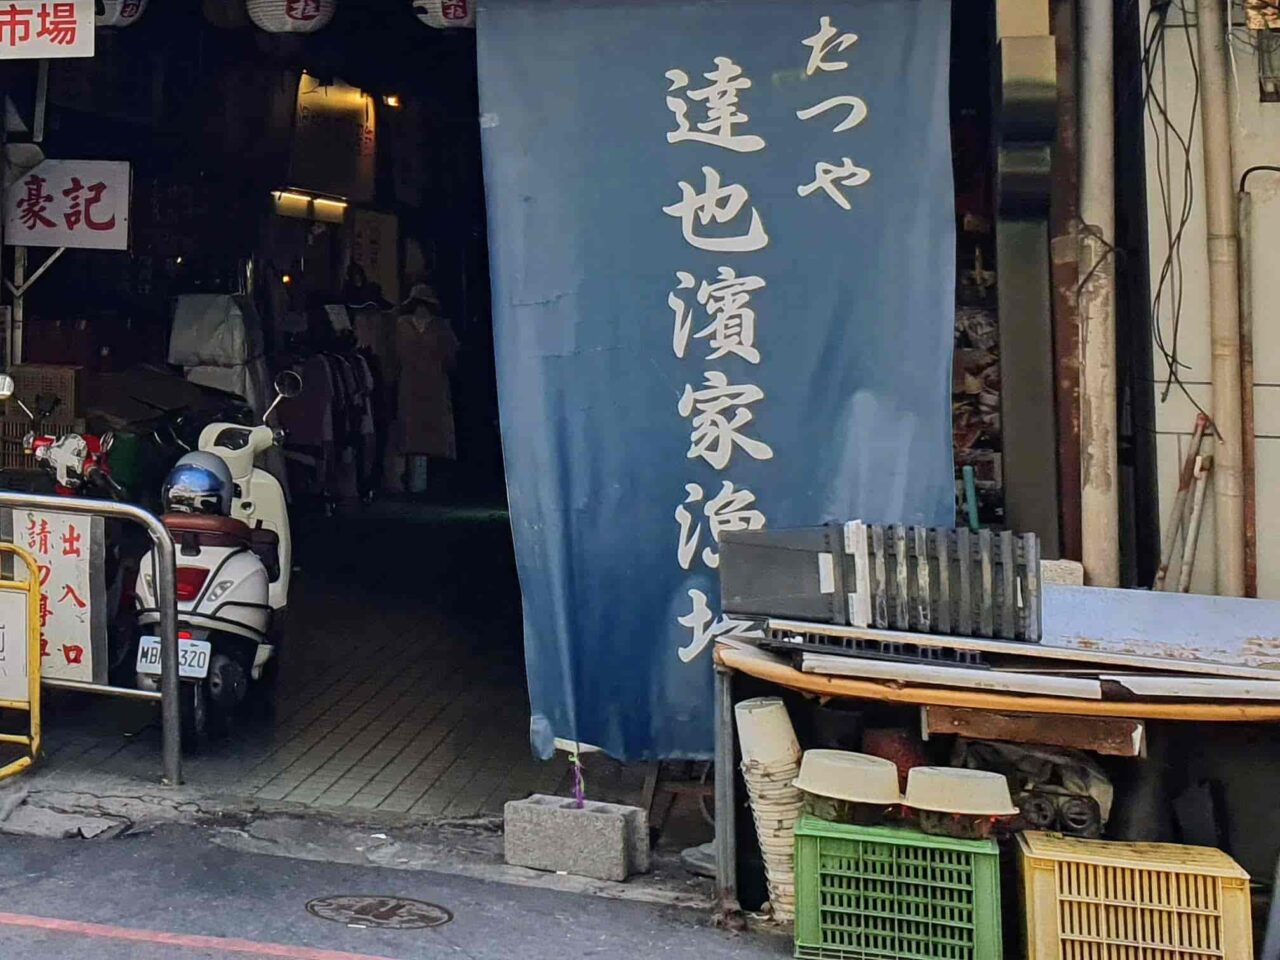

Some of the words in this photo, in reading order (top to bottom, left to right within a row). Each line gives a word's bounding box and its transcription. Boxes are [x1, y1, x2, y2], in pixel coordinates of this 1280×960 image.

[795, 15, 871, 210] たつや
[16, 174, 116, 232] 豪記
[57, 523, 86, 665] 出入口
